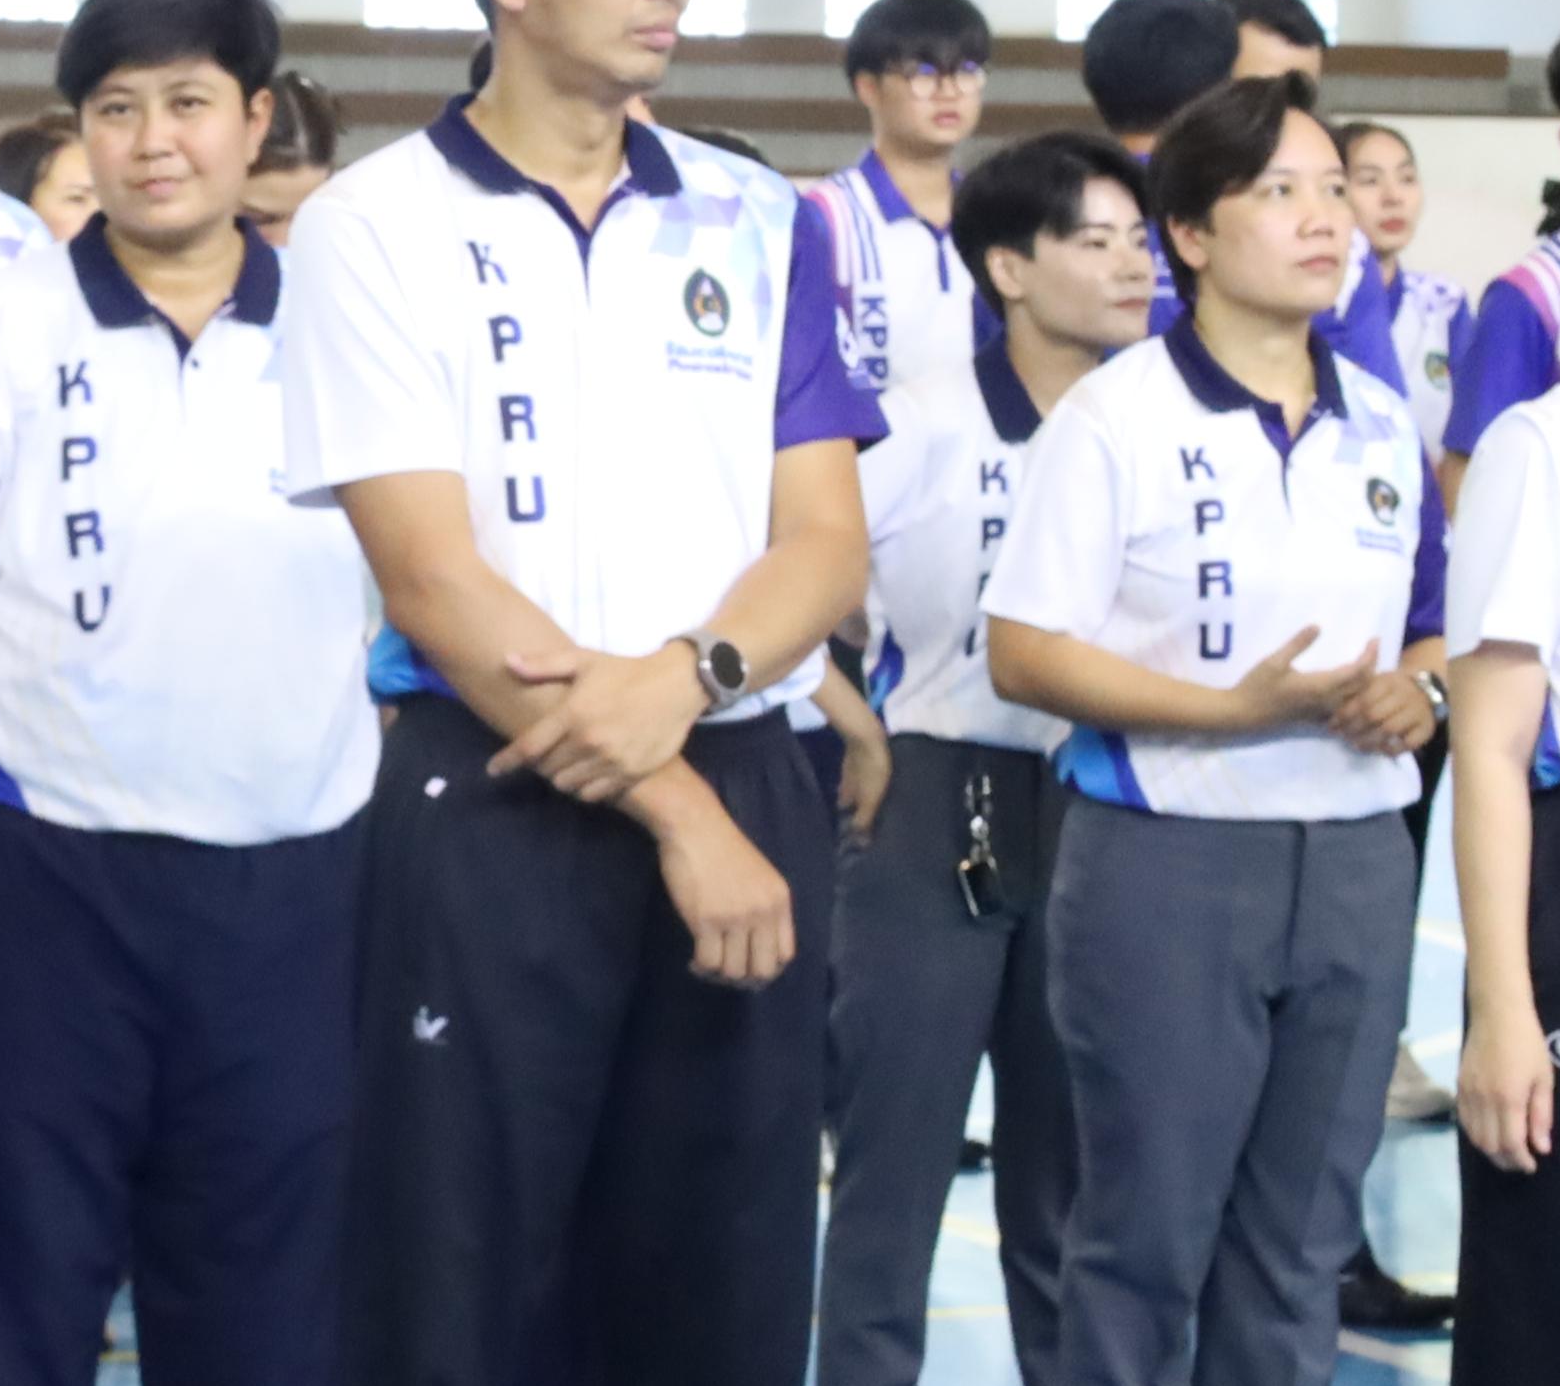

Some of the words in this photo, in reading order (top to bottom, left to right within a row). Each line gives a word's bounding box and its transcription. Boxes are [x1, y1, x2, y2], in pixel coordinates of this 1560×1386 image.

[58, 361, 111, 632] KPRU
[467, 241, 546, 522] KPRU
[1180, 446, 1234, 662] KPRU
